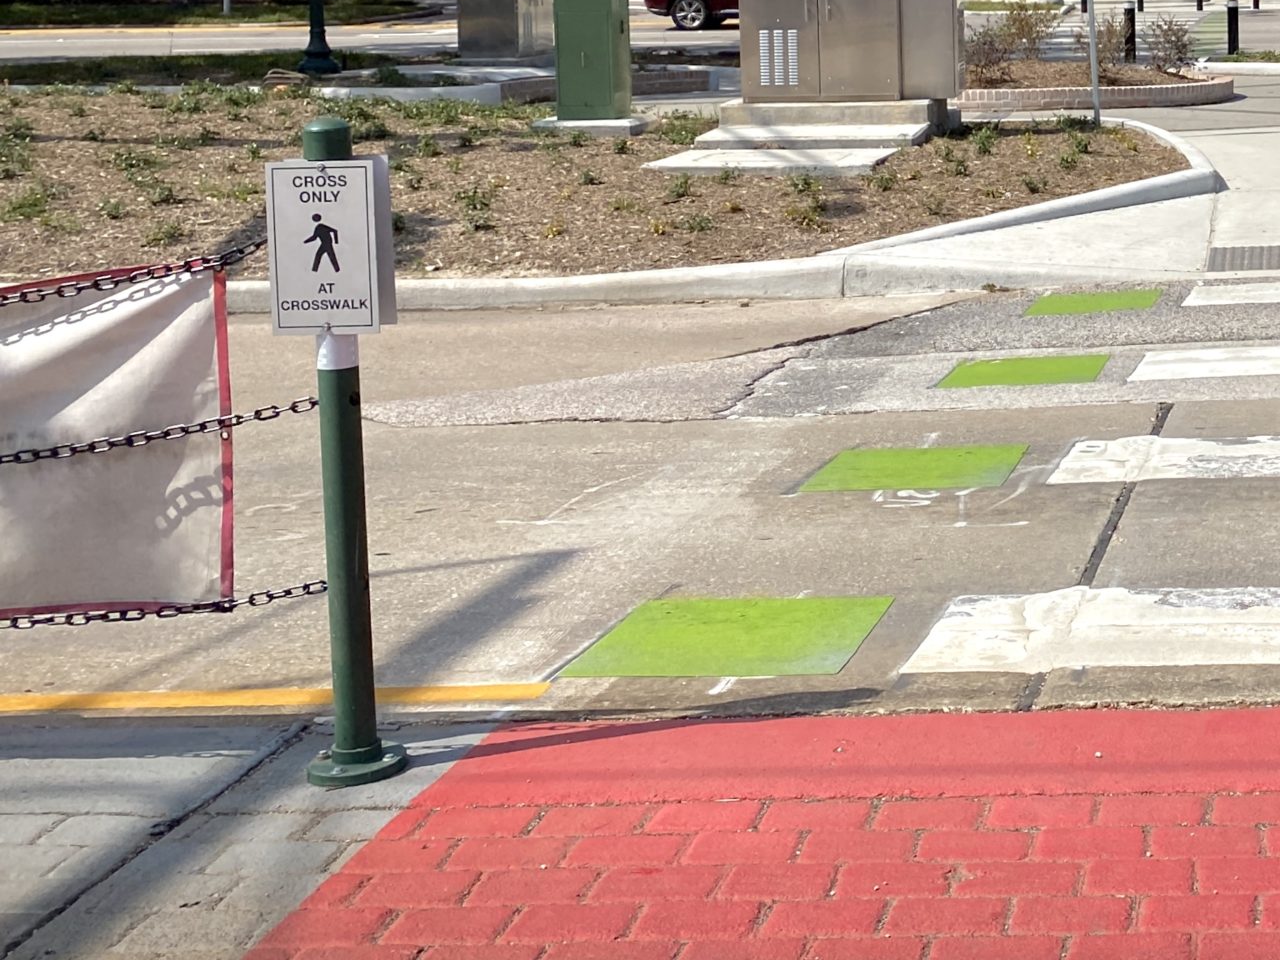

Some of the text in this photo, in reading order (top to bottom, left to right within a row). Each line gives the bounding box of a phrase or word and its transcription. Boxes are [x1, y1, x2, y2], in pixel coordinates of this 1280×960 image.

[292, 175, 348, 188] CROSS
[299, 190, 341, 204] ONLY
[318, 282, 336, 294] AT
[280, 299, 369, 311] CROSSWALK
